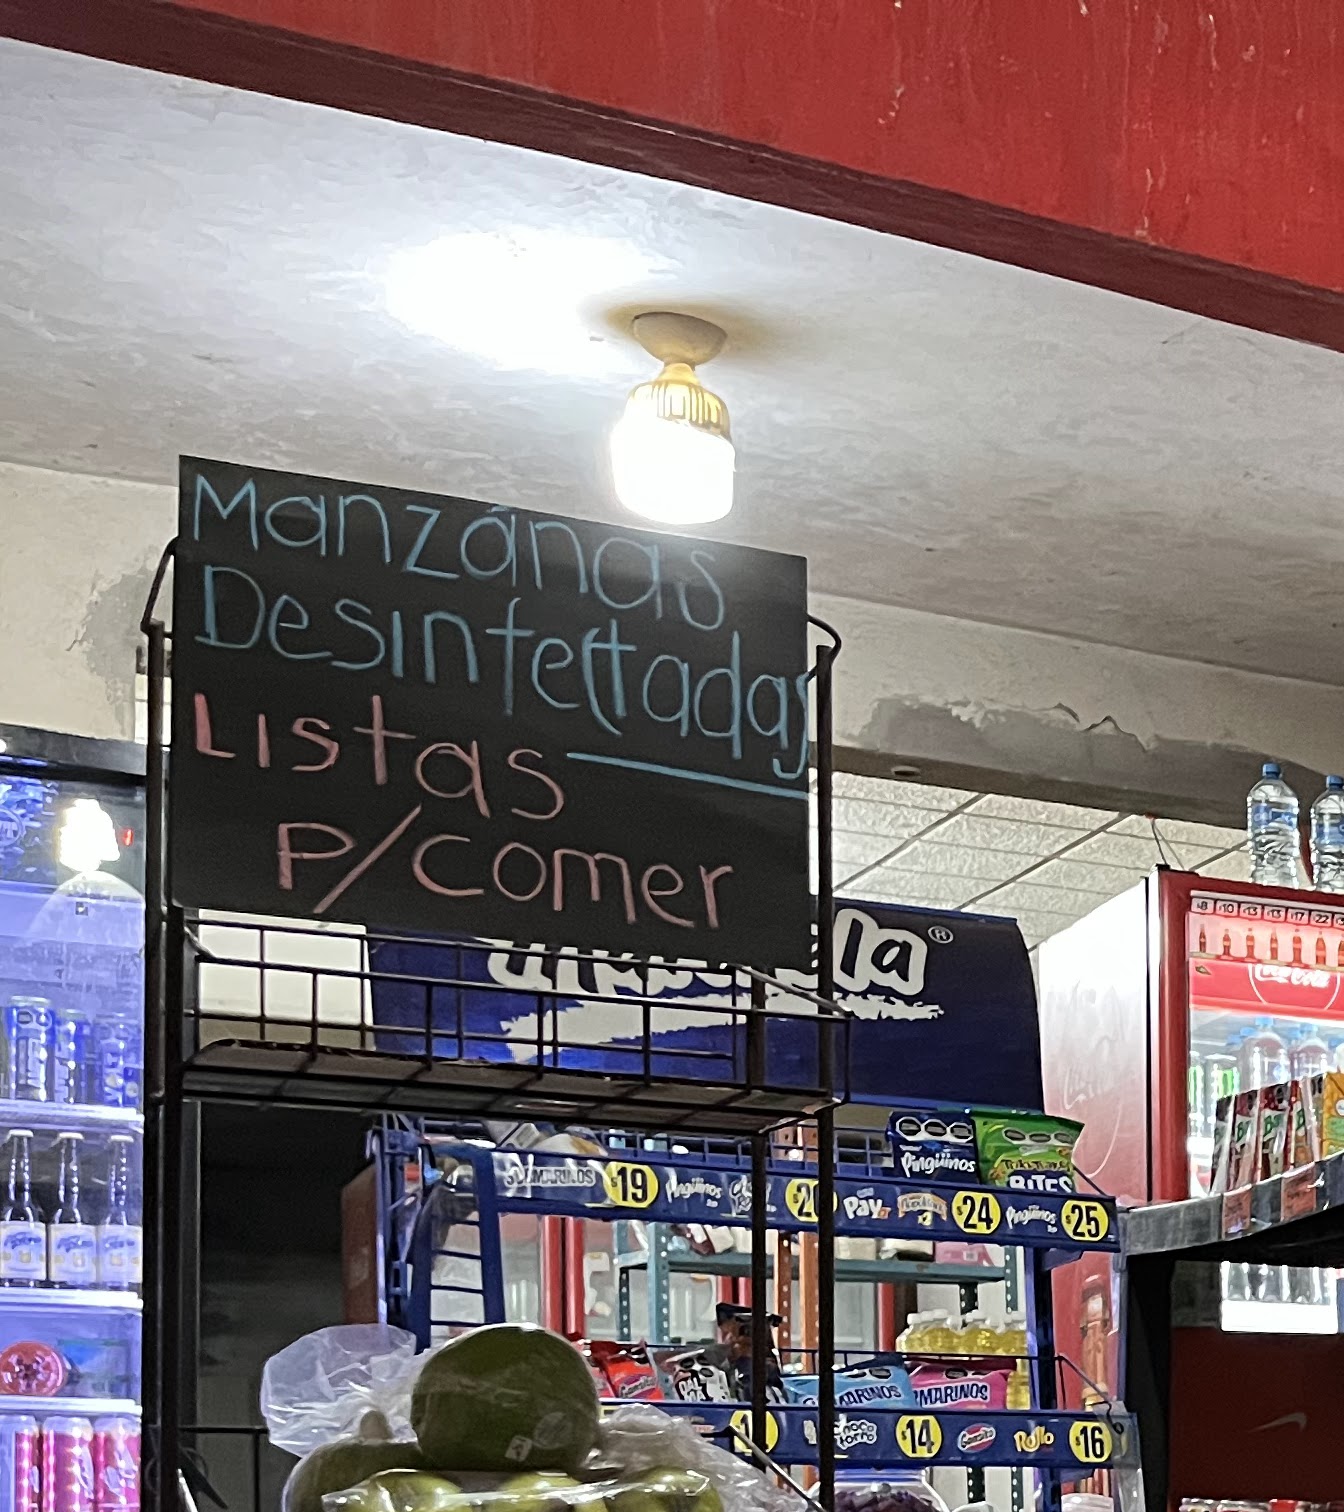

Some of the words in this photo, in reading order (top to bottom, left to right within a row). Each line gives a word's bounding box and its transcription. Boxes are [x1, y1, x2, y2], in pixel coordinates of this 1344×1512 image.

[193, 693, 564, 820] Listas
[900, 1150, 976, 1178] Pingüinos
[957, 1195, 993, 1230] $24
[1066, 1203, 1100, 1238] $25
[901, 1418, 935, 1455] $14
[1075, 1425, 1105, 1460] $16
